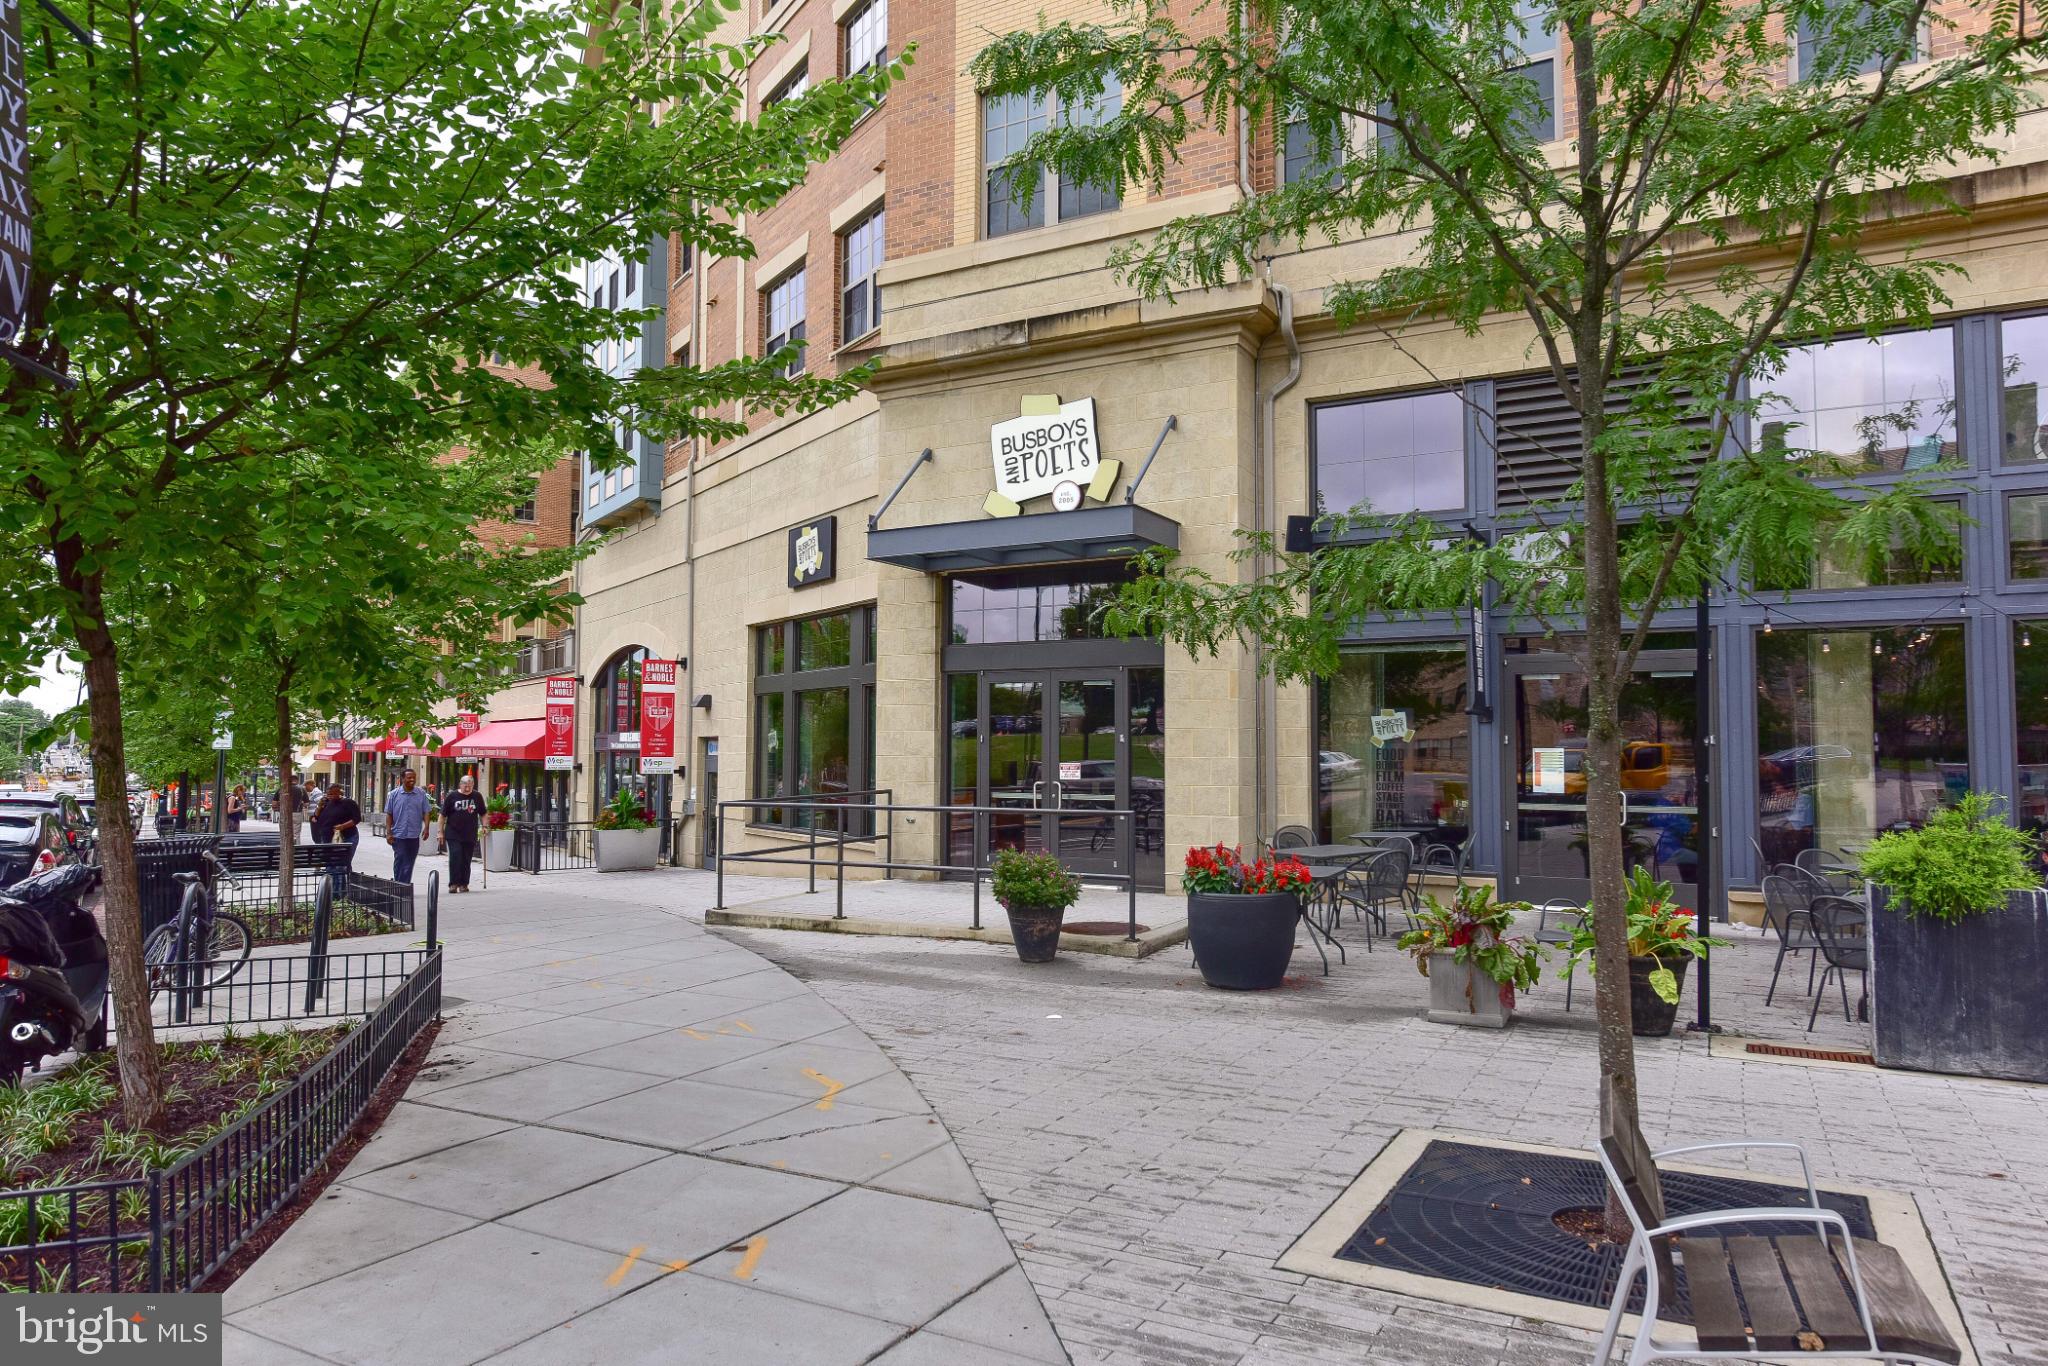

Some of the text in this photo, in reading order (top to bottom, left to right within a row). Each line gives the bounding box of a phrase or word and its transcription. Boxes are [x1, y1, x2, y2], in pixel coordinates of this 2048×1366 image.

[1001, 418, 1087, 455] BUSBOYS
[1005, 438, 1090, 484] AND POETS
[645, 663, 673, 673] BARNES
[549, 680, 573, 689] BARNES
[1376, 771, 1405, 782] FILM
[1376, 782, 1405, 791] COFFEE
[1376, 792, 1405, 802] STAGE
[455, 799, 476, 811] CUA
[1376, 809, 1404, 823] BAR
